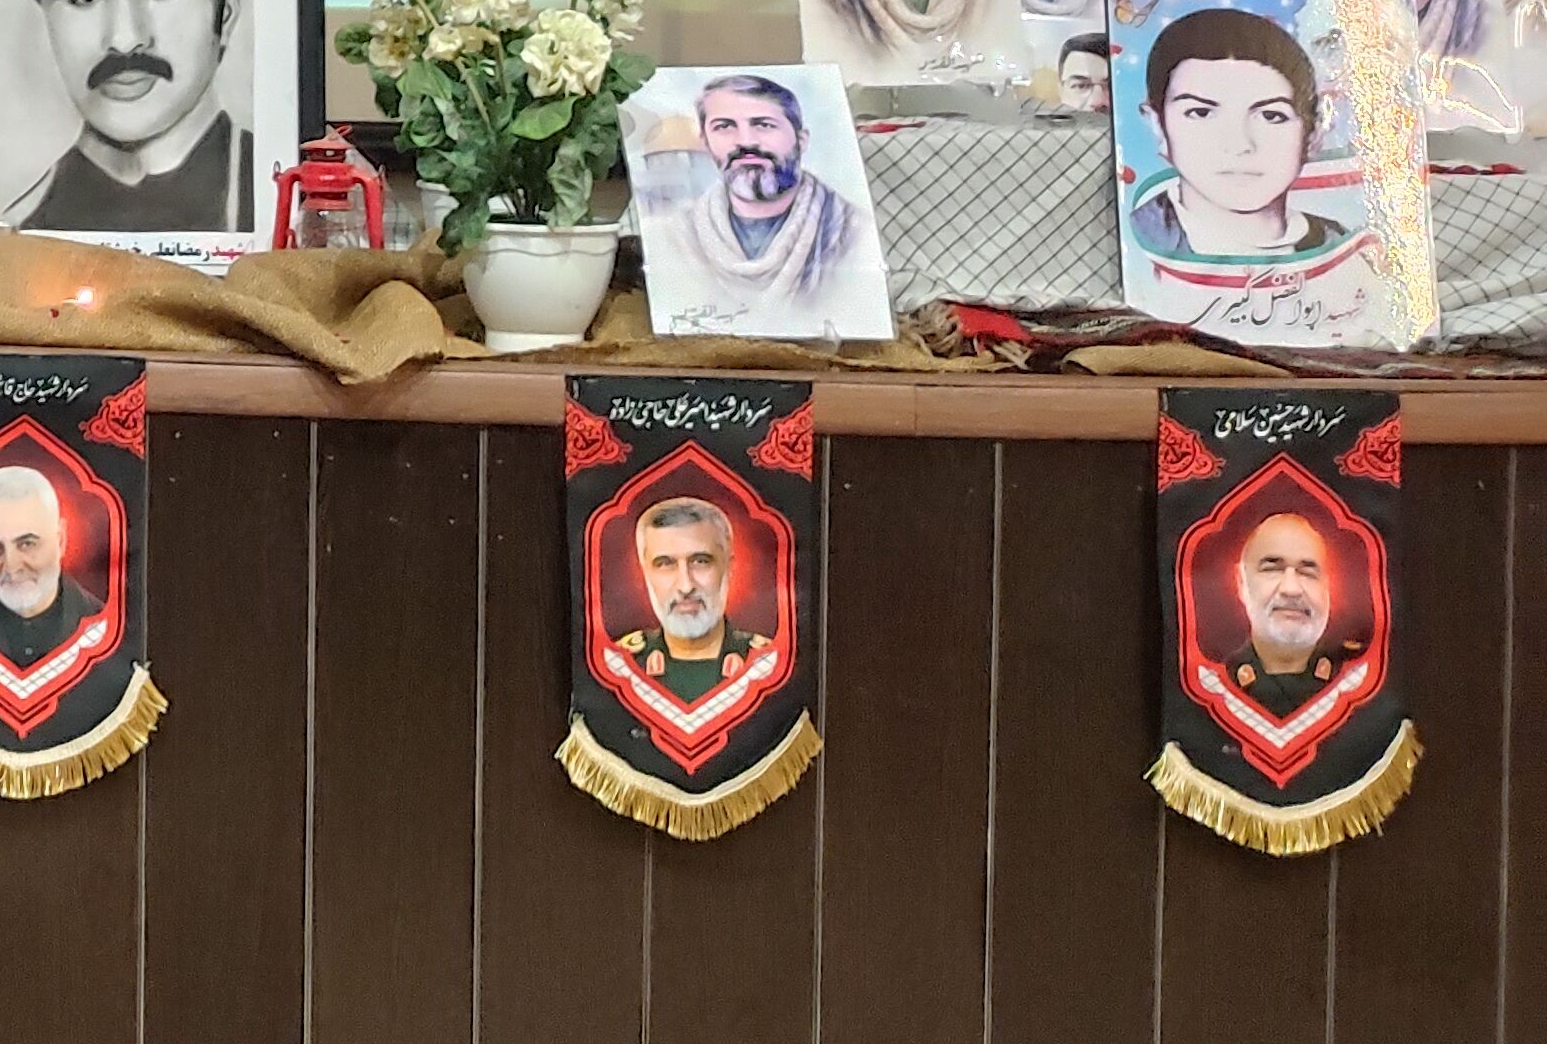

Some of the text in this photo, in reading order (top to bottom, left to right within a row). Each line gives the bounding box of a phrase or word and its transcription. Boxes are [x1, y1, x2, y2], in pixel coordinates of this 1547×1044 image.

[212, 242, 245, 260] شهید
[1188, 267, 1275, 327] کبیری
[1325, 288, 1366, 338] شهید
[13, 378, 35, 403] حاج
[35, 375, 60, 403] شهید
[58, 377, 89, 403] سردار
[731, 397, 772, 428] سردار
[1215, 403, 1346, 443] سردار شهید حسین سلامی
